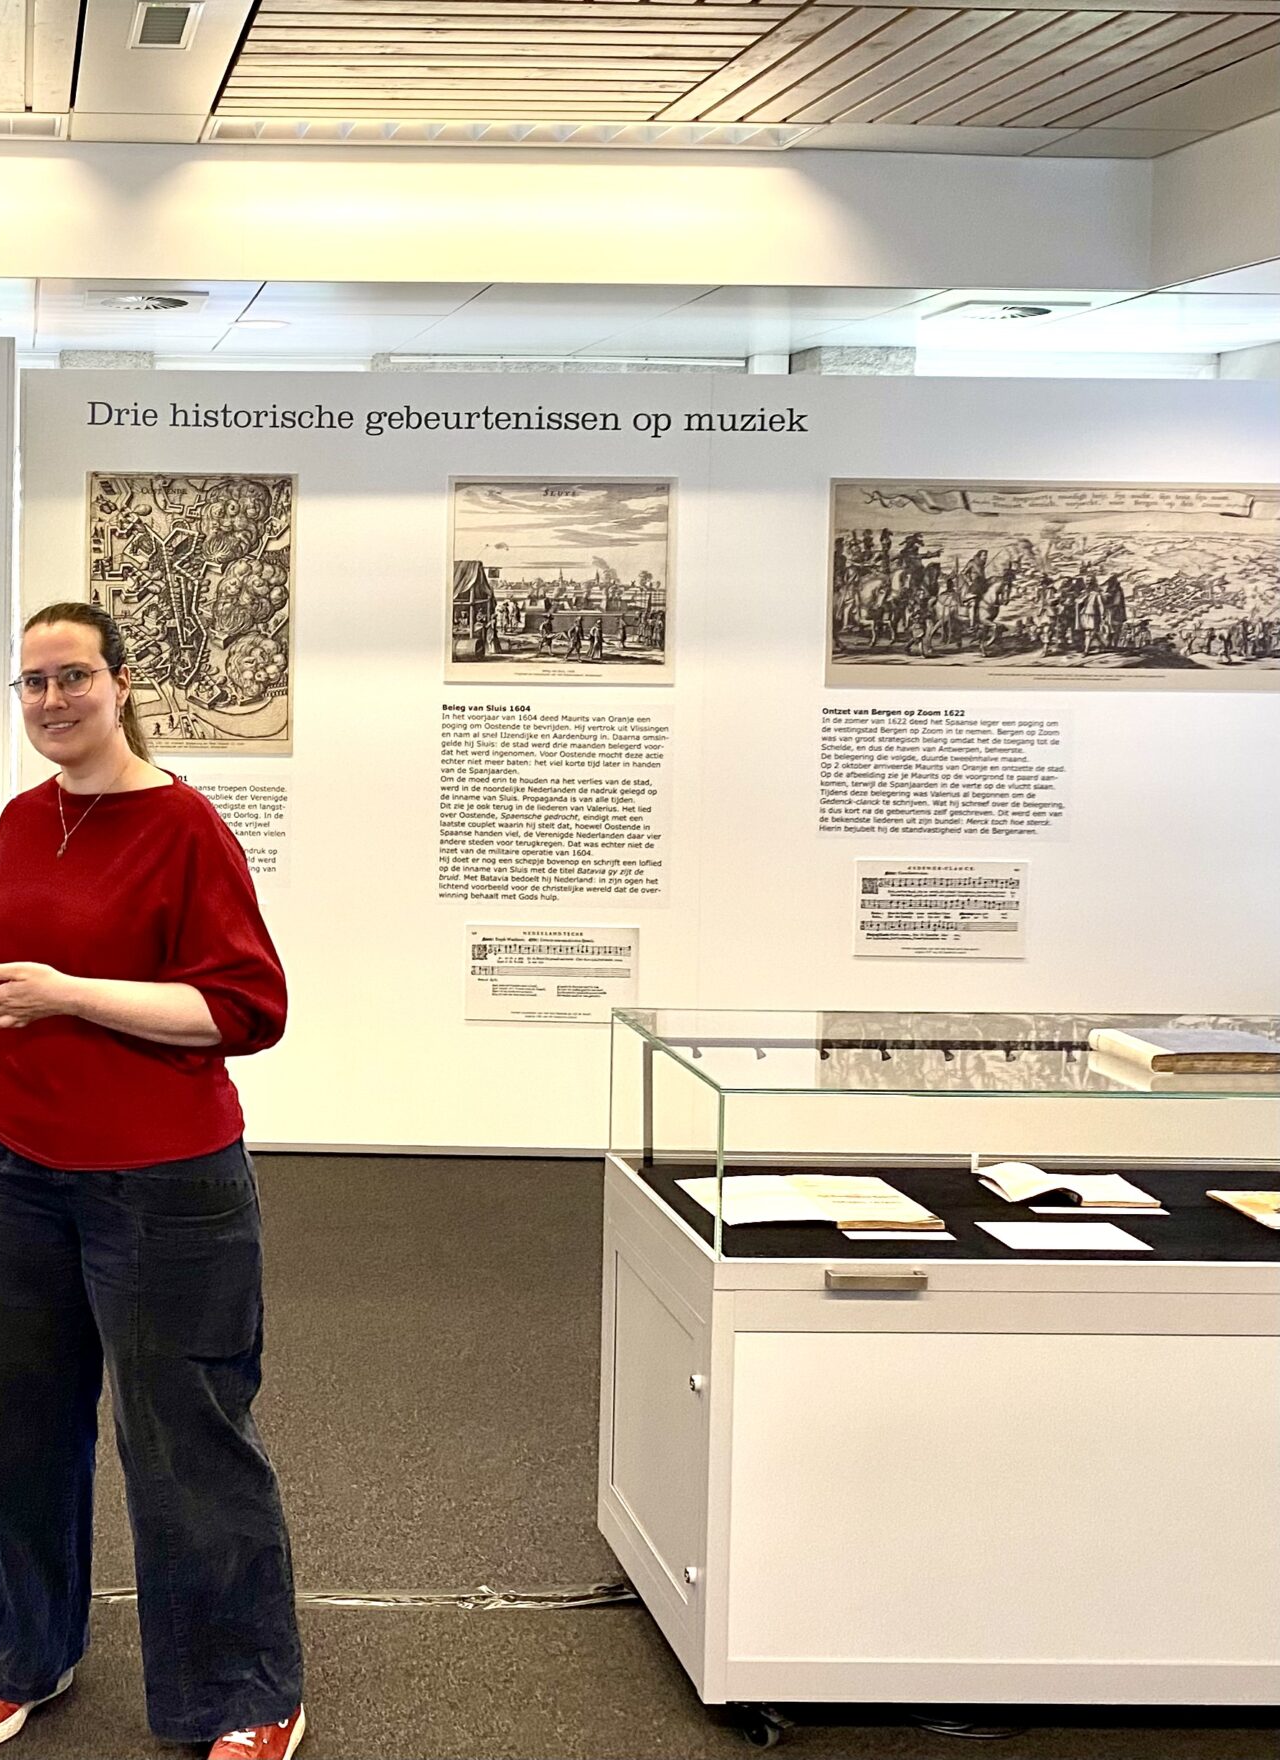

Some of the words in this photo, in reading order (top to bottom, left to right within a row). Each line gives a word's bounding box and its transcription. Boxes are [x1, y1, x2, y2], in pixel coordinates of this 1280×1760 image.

[87, 401, 158, 427] Drie
[169, 403, 354, 429] historische
[365, 404, 621, 439] gebeurtenissen
[633, 413, 671, 438] op
[684, 407, 808, 433] muziek
[442, 704, 466, 712] Beleg
[822, 707, 851, 715] Ontzet
[871, 708, 902, 716] Bergen
[917, 709, 941, 717] Zoom
[944, 709, 965, 717] 1622
[608, 715, 634, 723] Oranje
[484, 722, 520, 730] Oostende
[533, 724, 571, 732] bevrijden.
[630, 725, 669, 733] Vlissingen
[250, 794, 288, 802] Verenigde
[260, 803, 286, 811] langst-
[234, 812, 261, 820] Oorlog.
[245, 821, 270, 829] vrijwel
